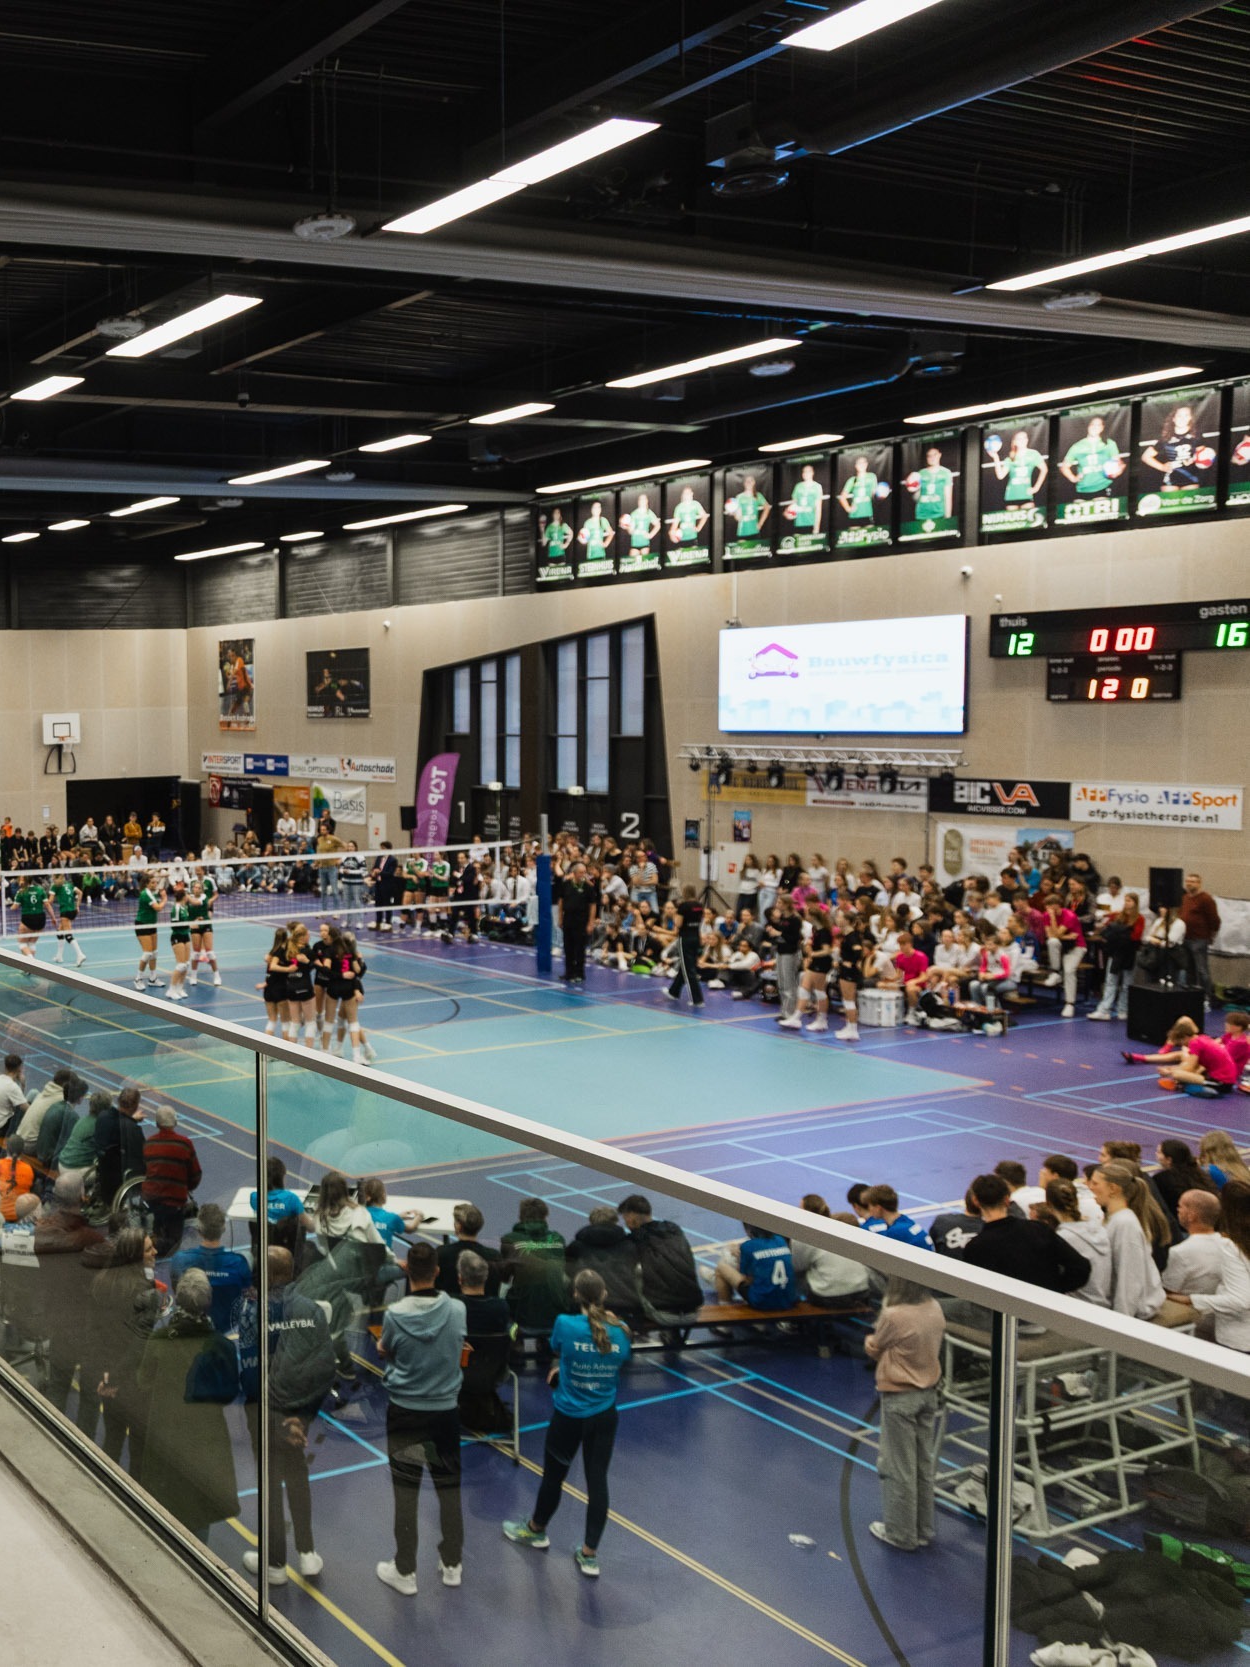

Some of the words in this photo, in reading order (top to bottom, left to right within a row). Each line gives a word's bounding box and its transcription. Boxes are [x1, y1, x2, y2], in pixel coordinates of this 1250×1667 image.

[1199, 604, 1248, 619] gasten
[1000, 617, 1027, 628] thuis
[1216, 623, 1249, 647] 16
[1008, 633, 1034, 655] 12
[808, 651, 950, 668] Bouwfysica
[351, 762, 395, 774] Autoschade
[333, 791, 365, 813] Basis
[458, 801, 466, 824] 1
[1088, 809, 1219, 824] afp-fysiotherapie.nl
[620, 812, 641, 838] 2
[30, 890, 38, 905] 6
[771, 1259, 789, 1286] 4
[573, 1341, 621, 1354] TELR
